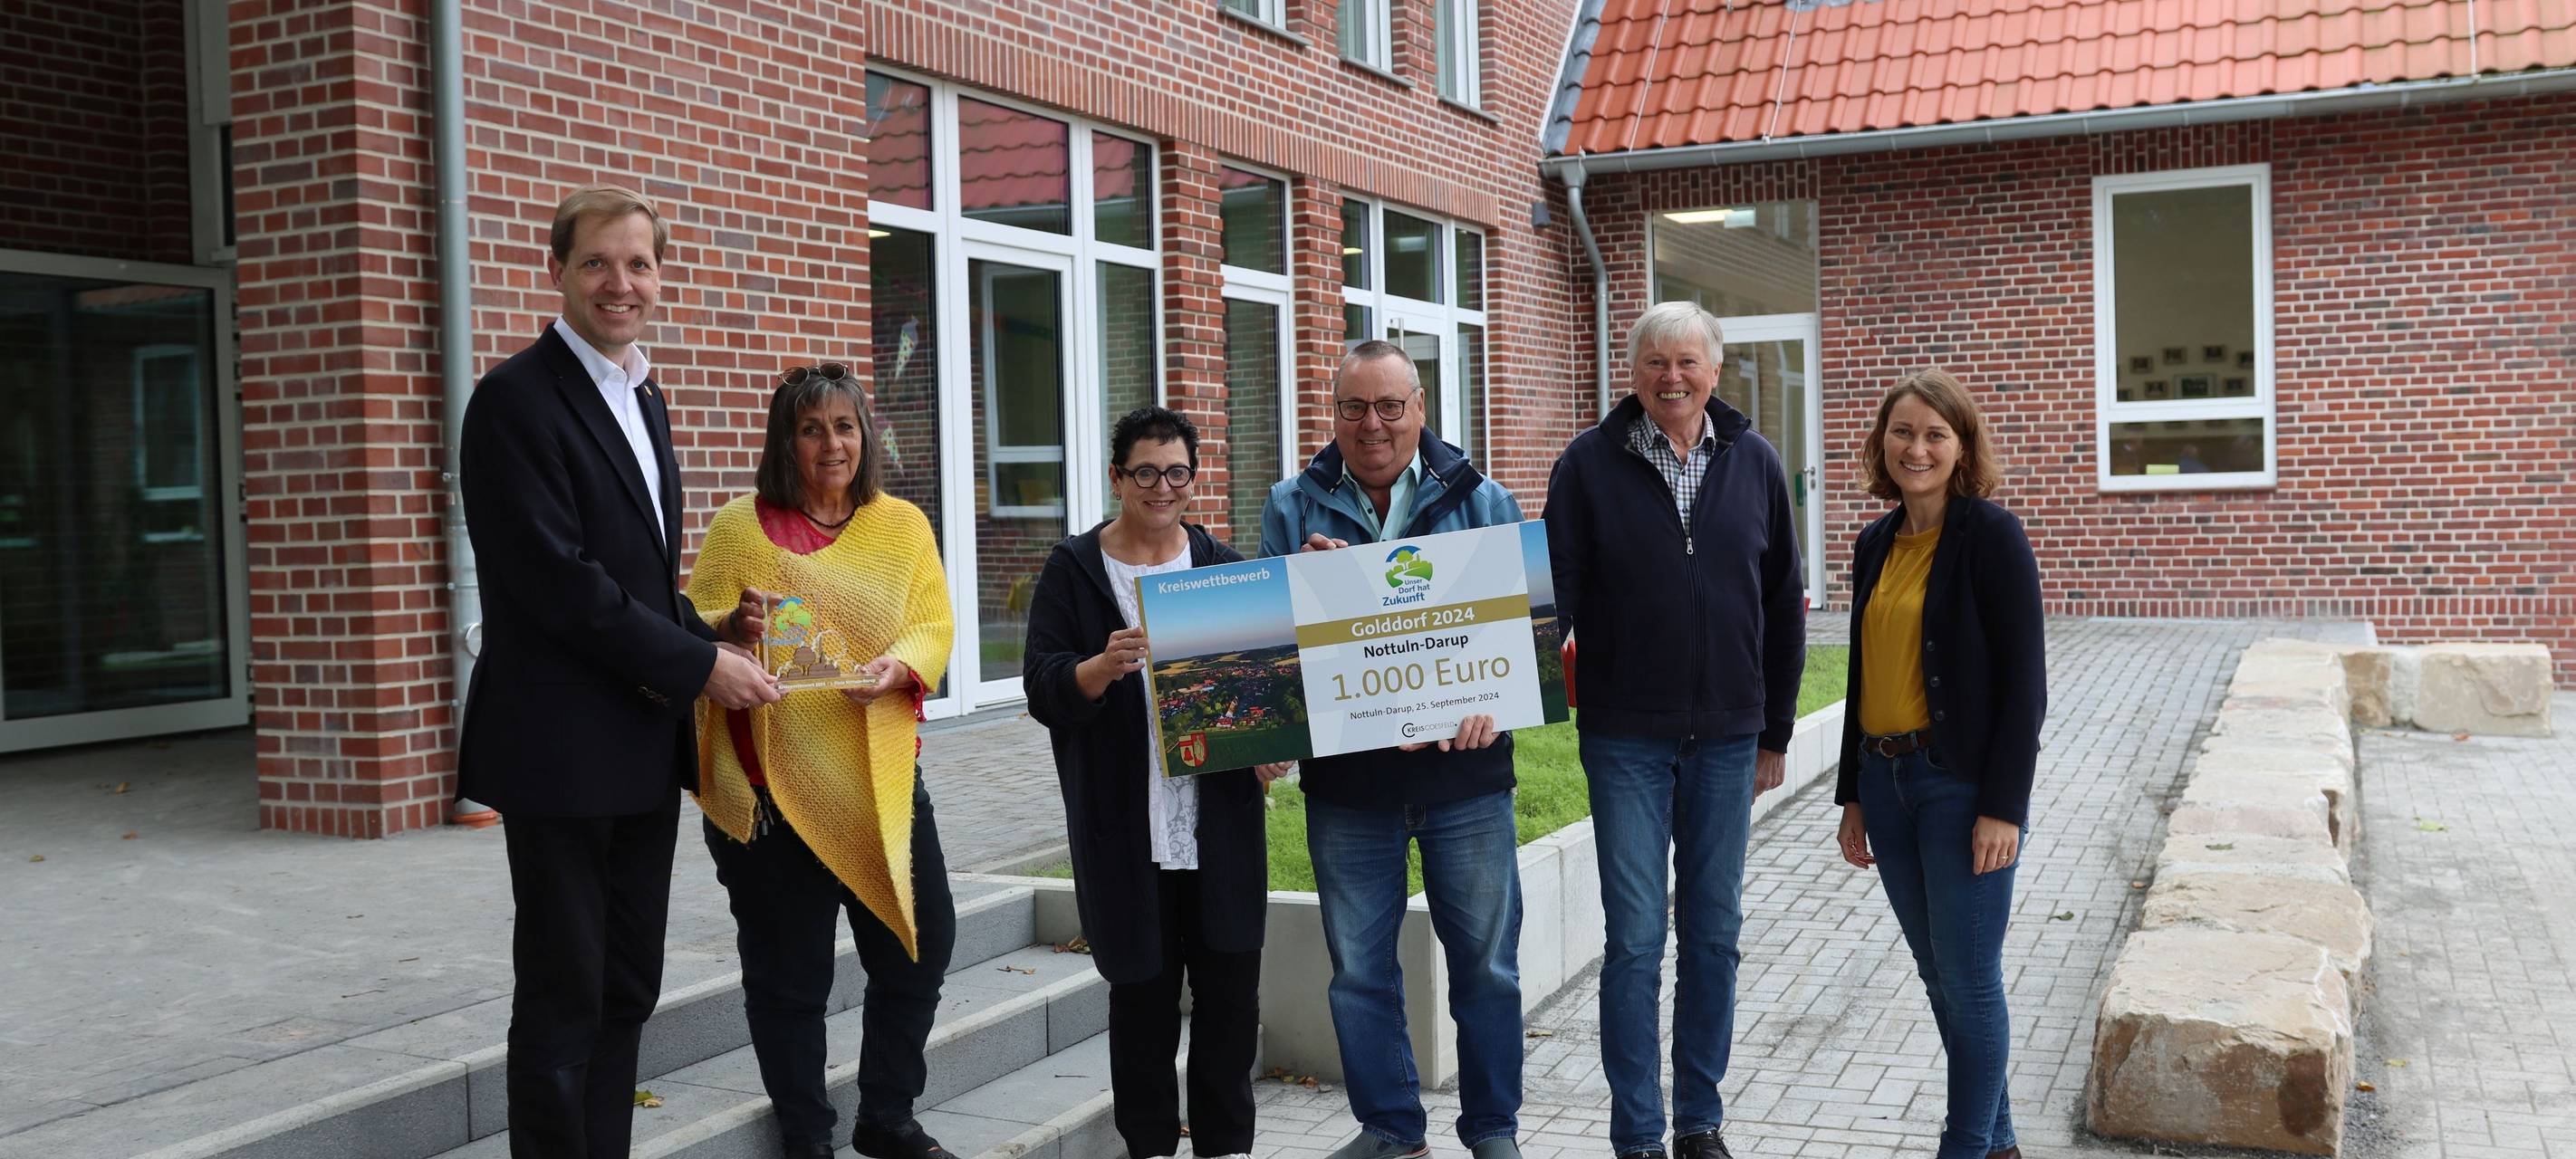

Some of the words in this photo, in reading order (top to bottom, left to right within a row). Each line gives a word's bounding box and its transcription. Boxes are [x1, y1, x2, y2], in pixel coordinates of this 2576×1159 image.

[1158, 568, 1270, 594] Kreiswettbewerb
[1399, 585, 1416, 594] Dorf
[1382, 592, 1426, 606] Zukunft
[1351, 612, 1427, 637] Golddorf
[1432, 607, 1475, 626] 2024
[1363, 635, 1469, 658] Nottuln-Darup
[1331, 663, 1425, 702] 1.000
[1435, 656, 1510, 686] Euro
[1350, 705, 1415, 720] Nottuln-Darup,
[1417, 702, 1429, 711] 25.
[1430, 695, 1476, 709] September
[1478, 692, 1500, 702] 2024
